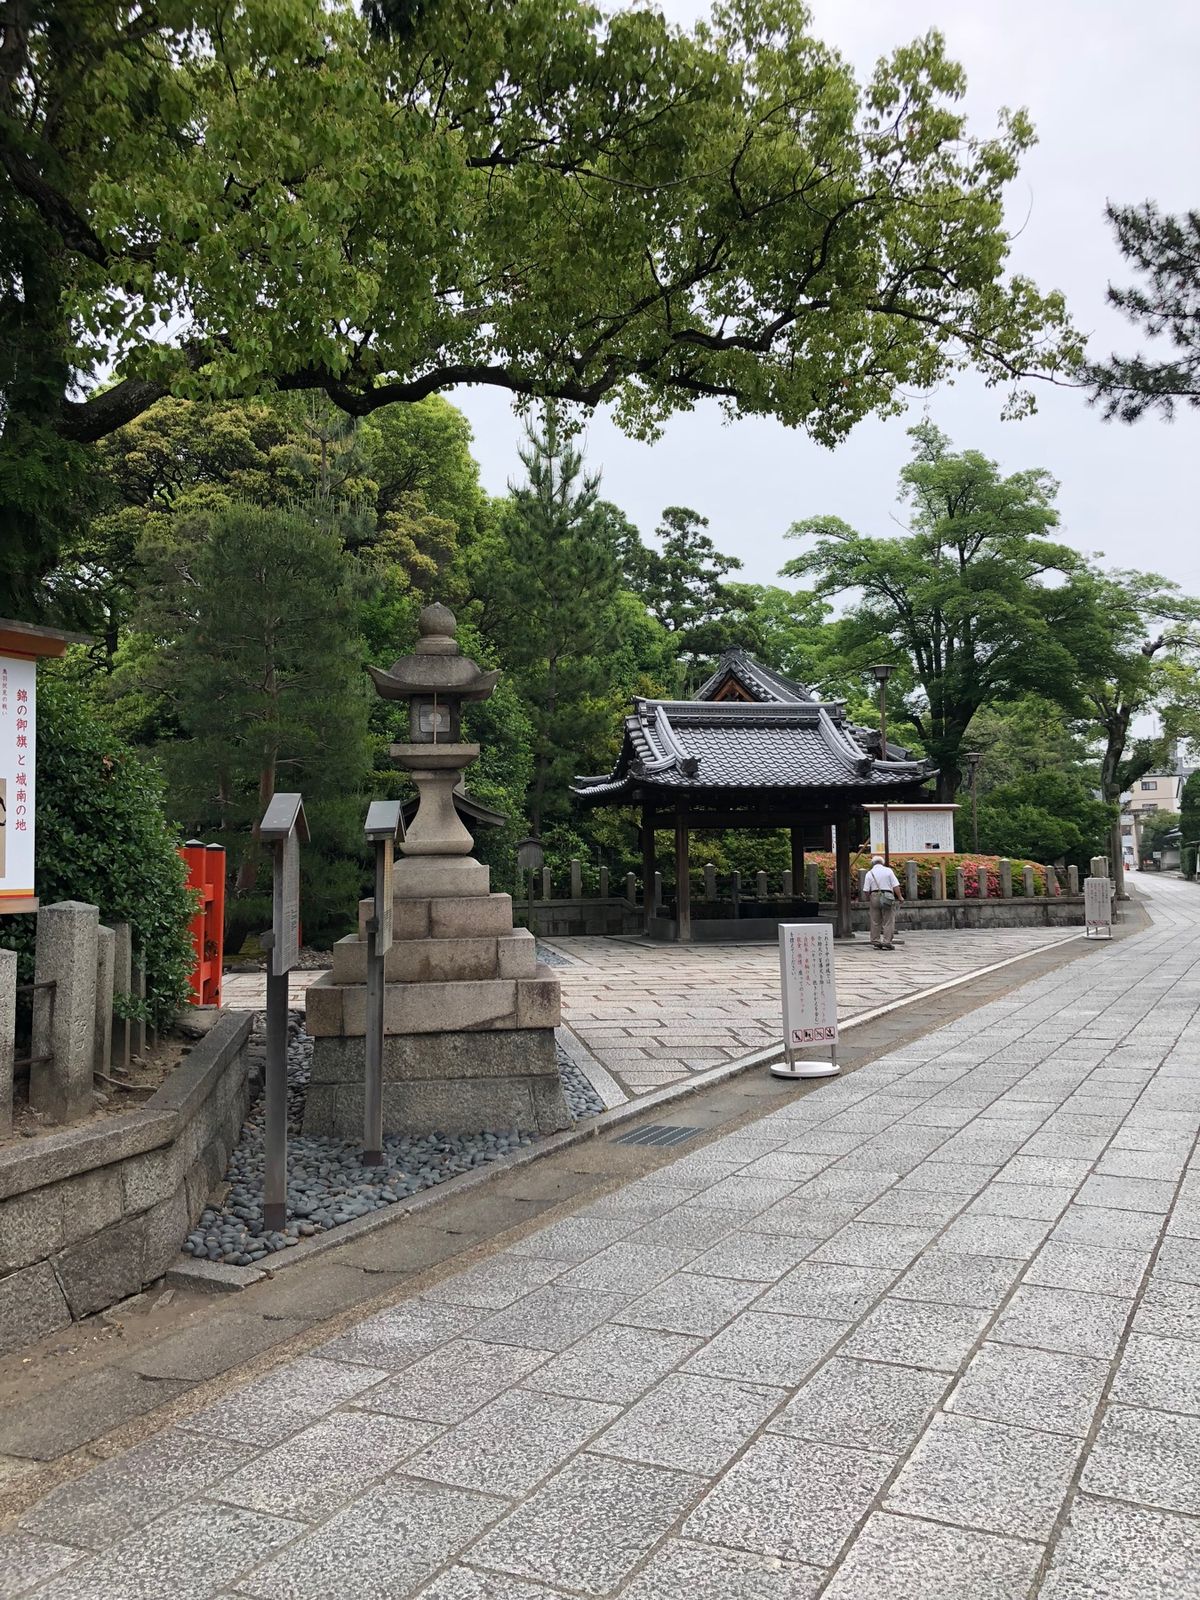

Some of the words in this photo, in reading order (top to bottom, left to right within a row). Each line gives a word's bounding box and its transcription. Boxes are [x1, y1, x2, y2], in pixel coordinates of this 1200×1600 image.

[15, 688, 28, 832] 錦の御旗と城南の地
